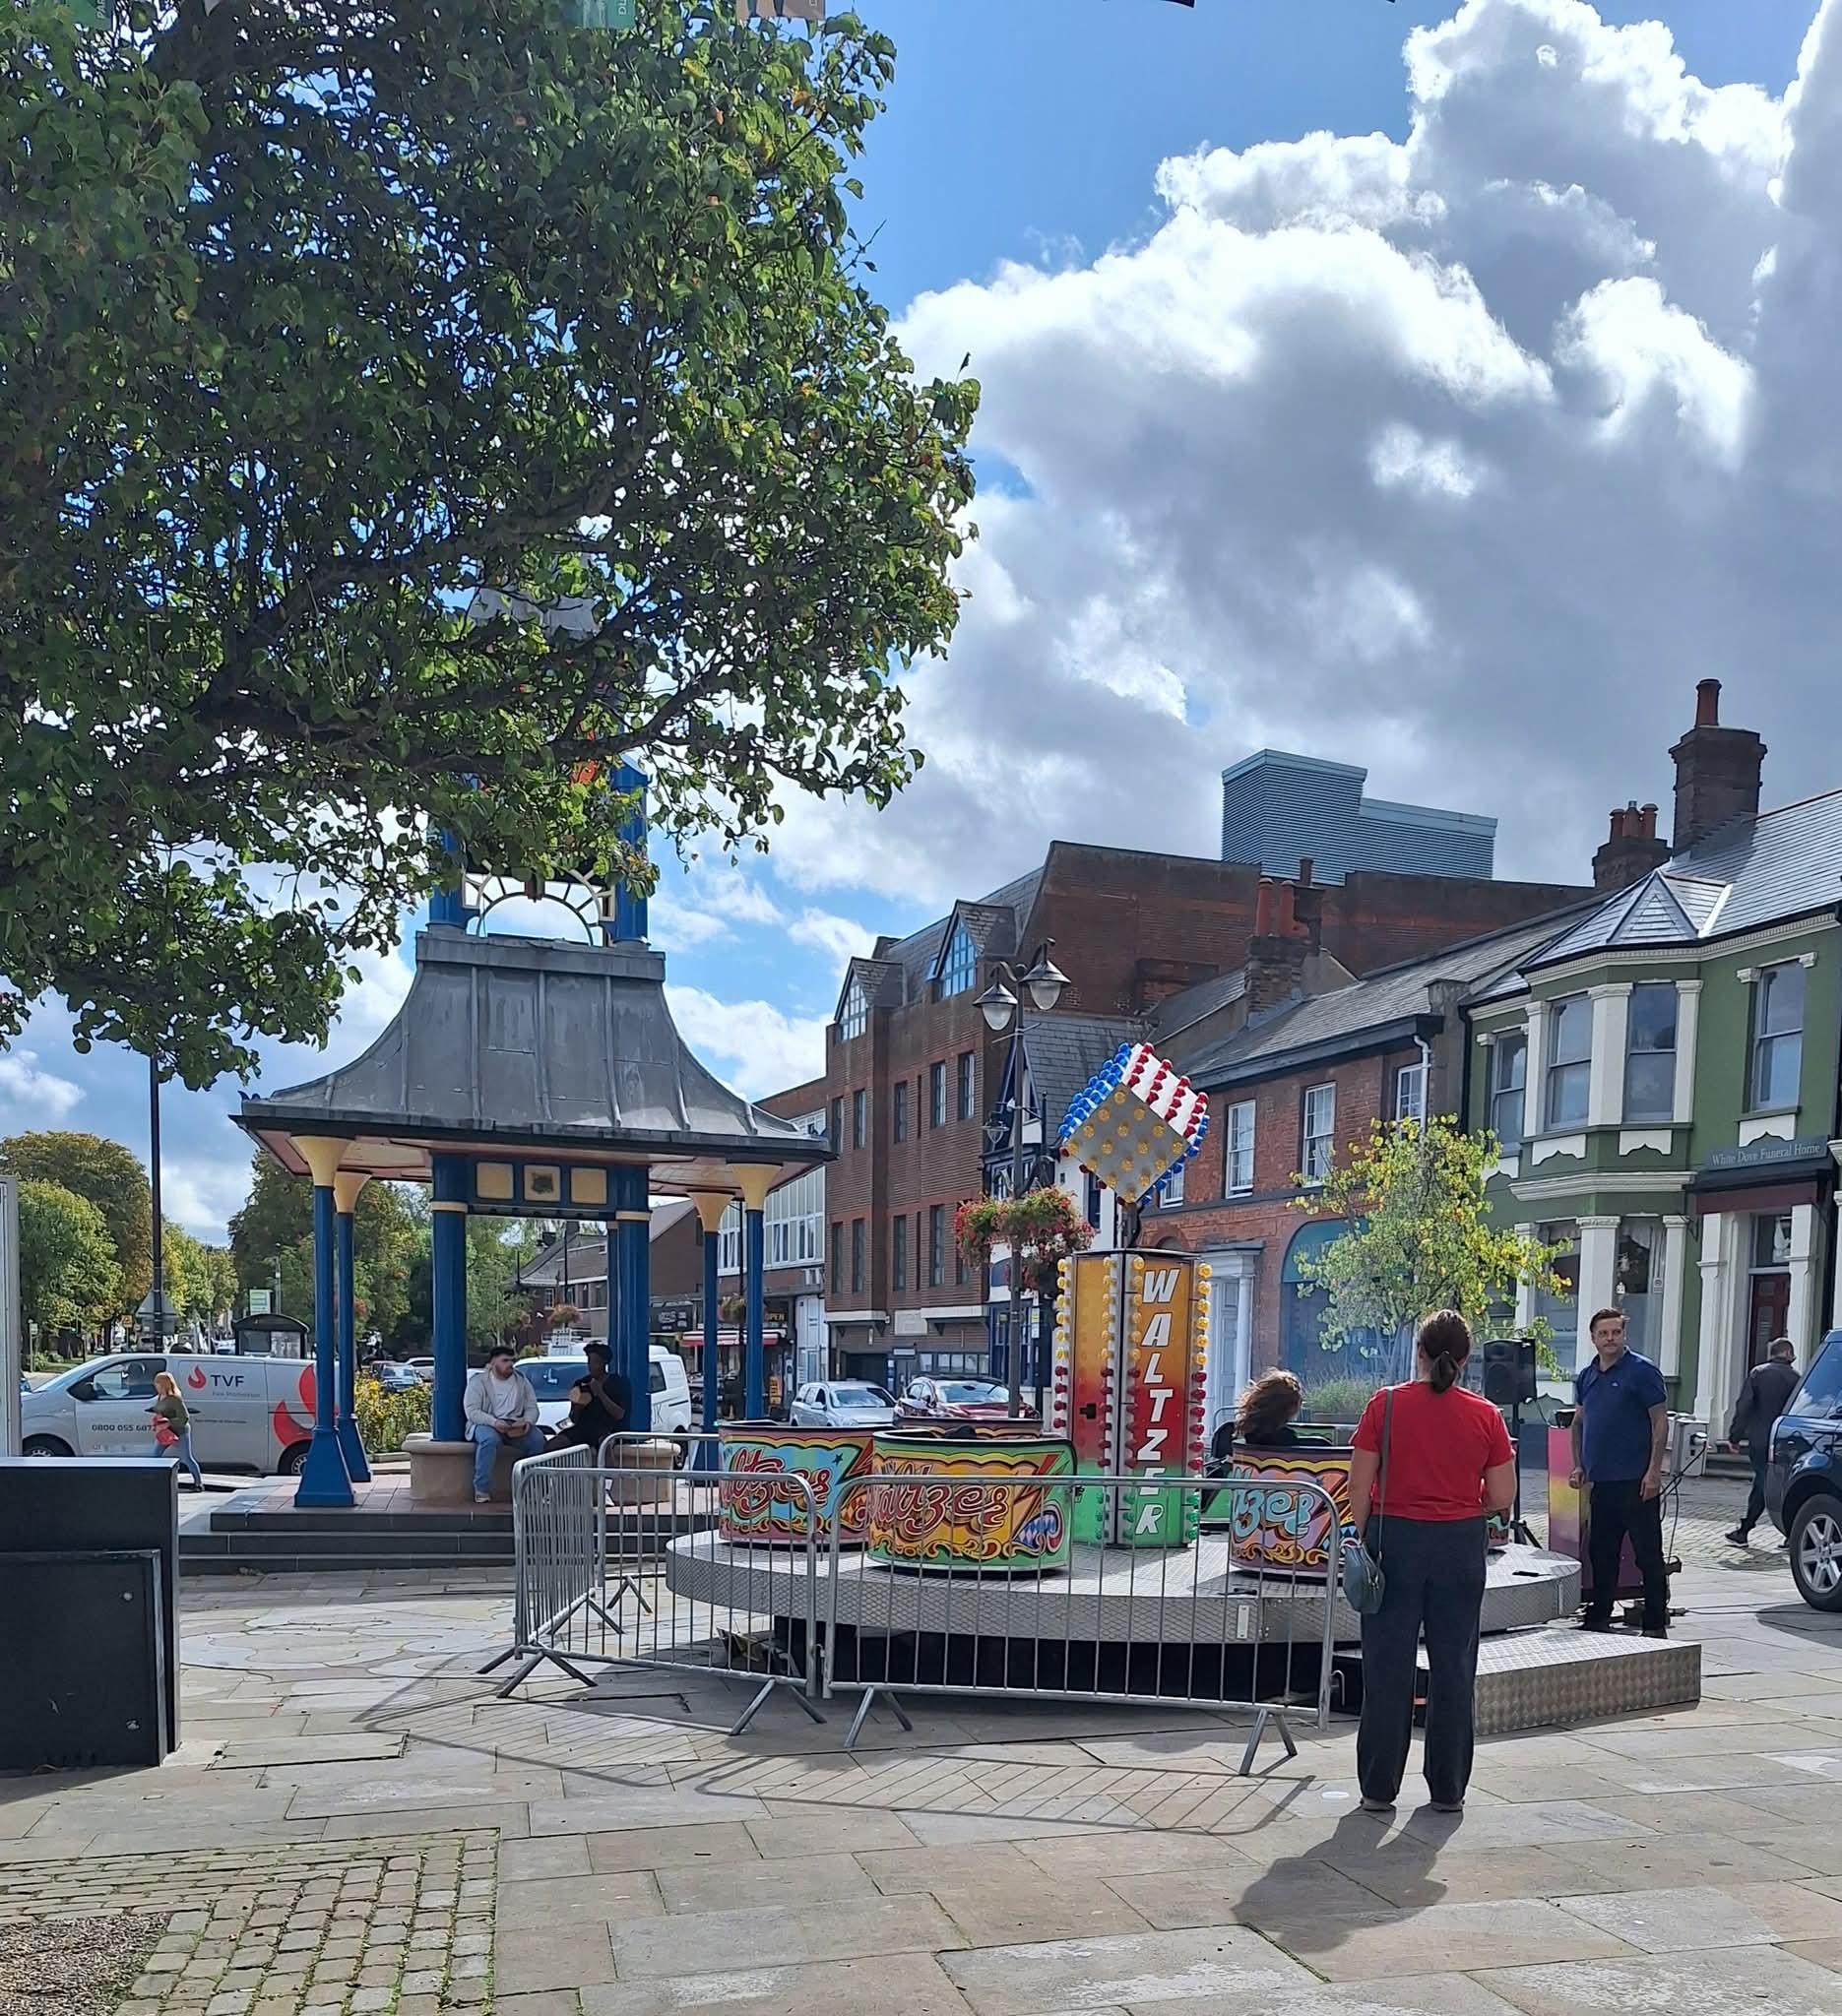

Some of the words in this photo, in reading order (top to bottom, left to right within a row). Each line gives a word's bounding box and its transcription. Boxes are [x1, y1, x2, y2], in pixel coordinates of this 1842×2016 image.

[1712, 1153, 1736, 1166] White
[1738, 1151, 1758, 1164] Dove
[1760, 1145, 1792, 1160] Funeral
[1794, 1143, 1820, 1156] Home
[210, 1374, 245, 1387] TVF
[1135, 1268, 1180, 1535] WALTZER
[92, 1423, 115, 1432] 0800
